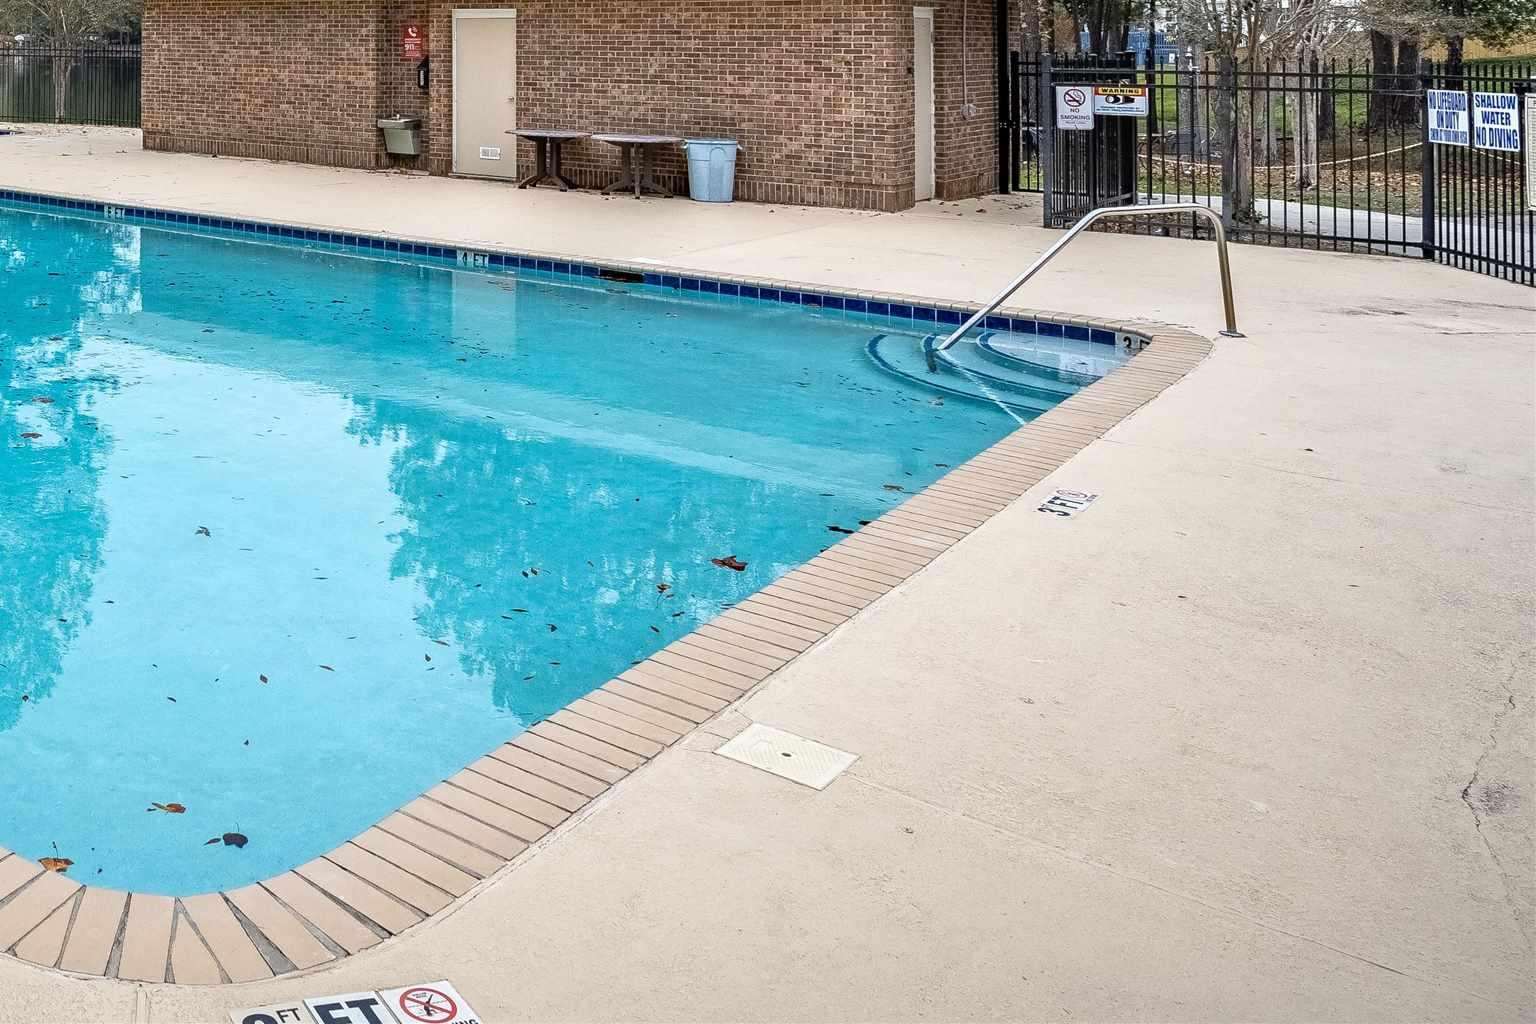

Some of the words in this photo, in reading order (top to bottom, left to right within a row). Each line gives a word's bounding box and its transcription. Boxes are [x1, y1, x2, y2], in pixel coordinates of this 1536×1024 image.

[1428, 90, 1436, 109] NO
[1437, 91, 1466, 111] LIFEGUARD
[1475, 94, 1516, 110] SHALLOW
[1436, 110, 1444, 128] ON
[1445, 111, 1459, 130] DUTY
[1481, 111, 1511, 126] WATER
[1476, 126, 1487, 146] NO
[1489, 127, 1519, 149] DIVING
[276, 1007, 301, 1024] FT
